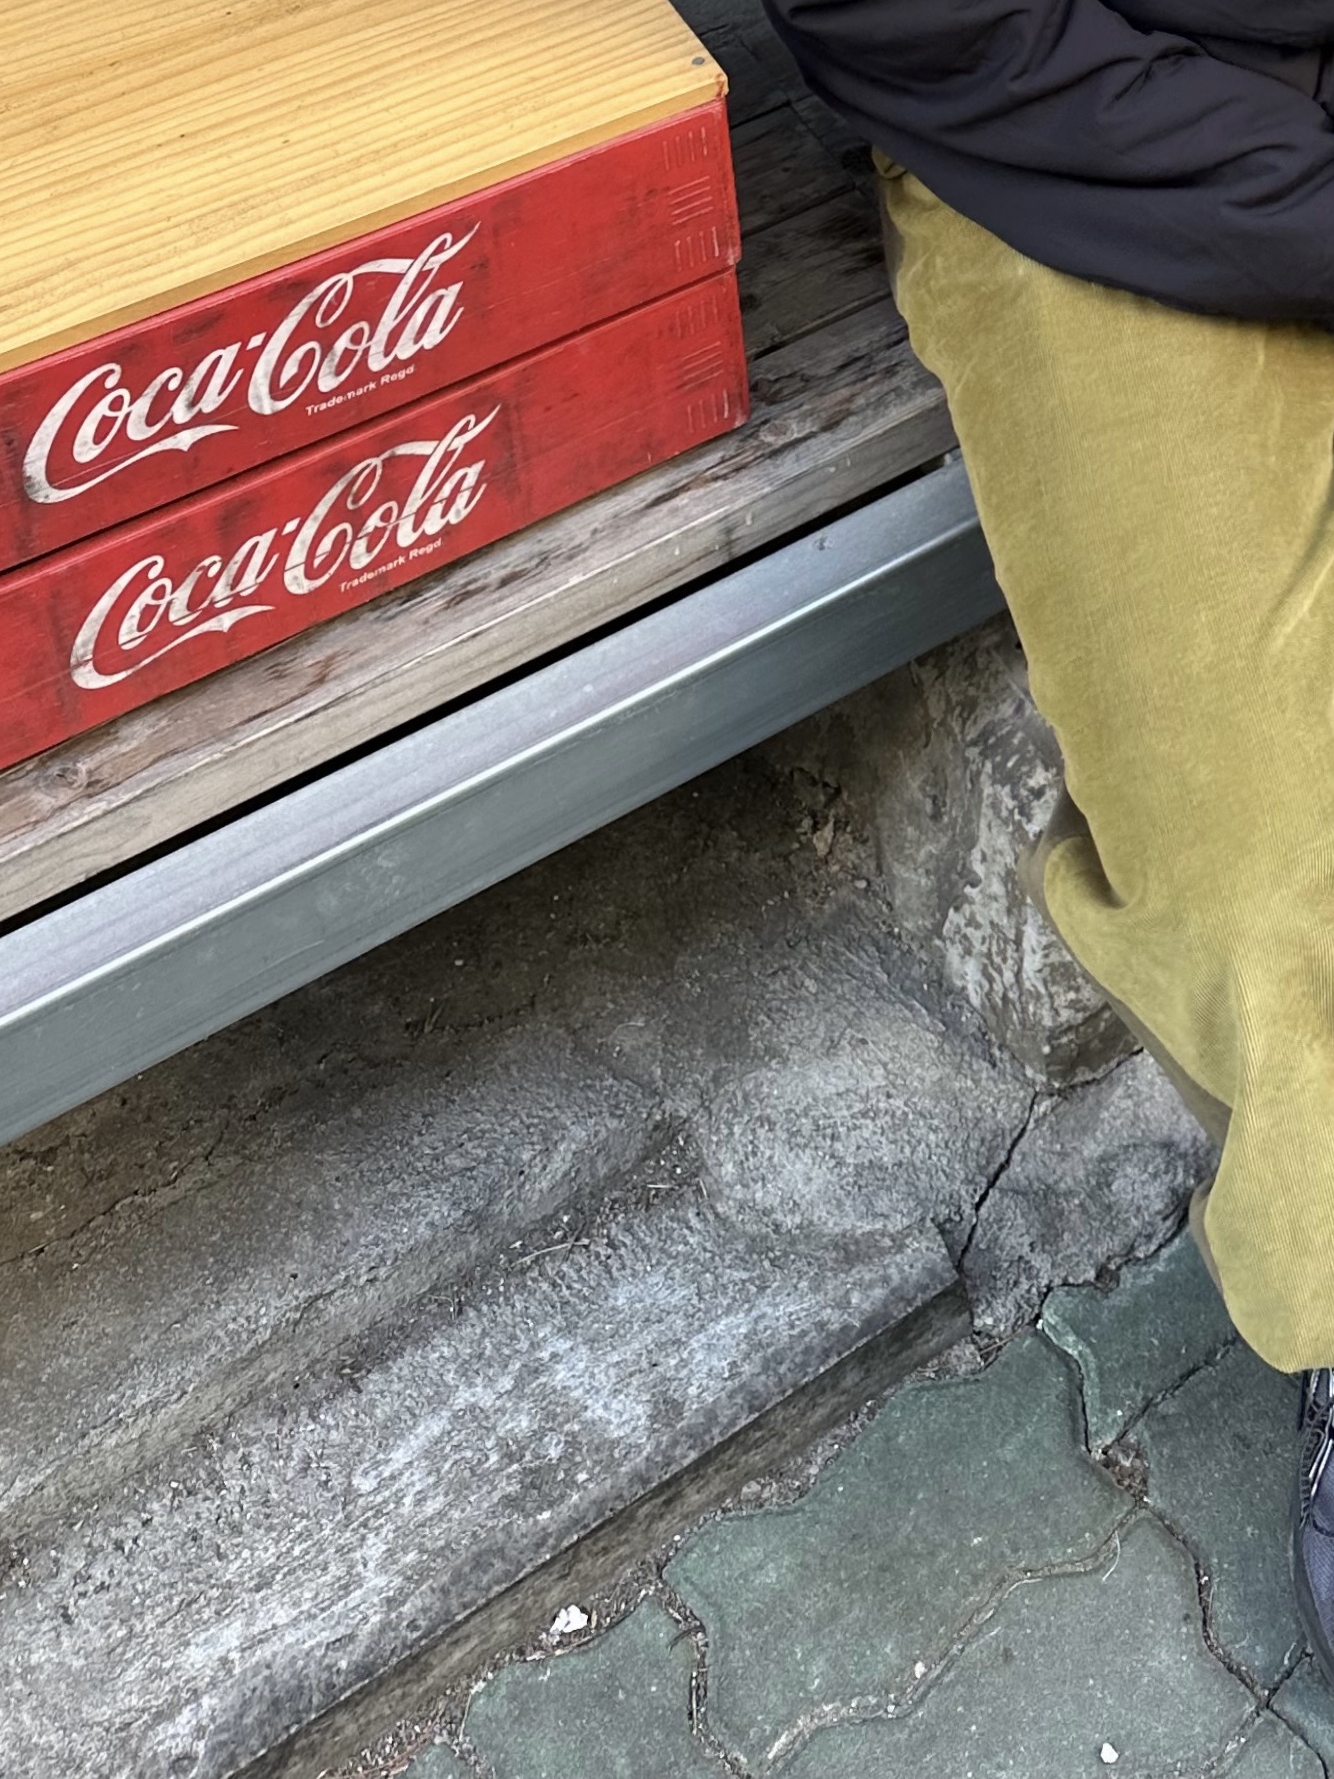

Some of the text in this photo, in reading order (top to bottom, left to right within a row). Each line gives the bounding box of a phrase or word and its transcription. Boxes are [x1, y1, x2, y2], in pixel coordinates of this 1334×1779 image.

[22, 221, 482, 505] Coca-Cola
[305, 382, 378, 417] Trademark
[69, 403, 501, 691] Coca-Cola
[339, 556, 406, 593] Trademark
